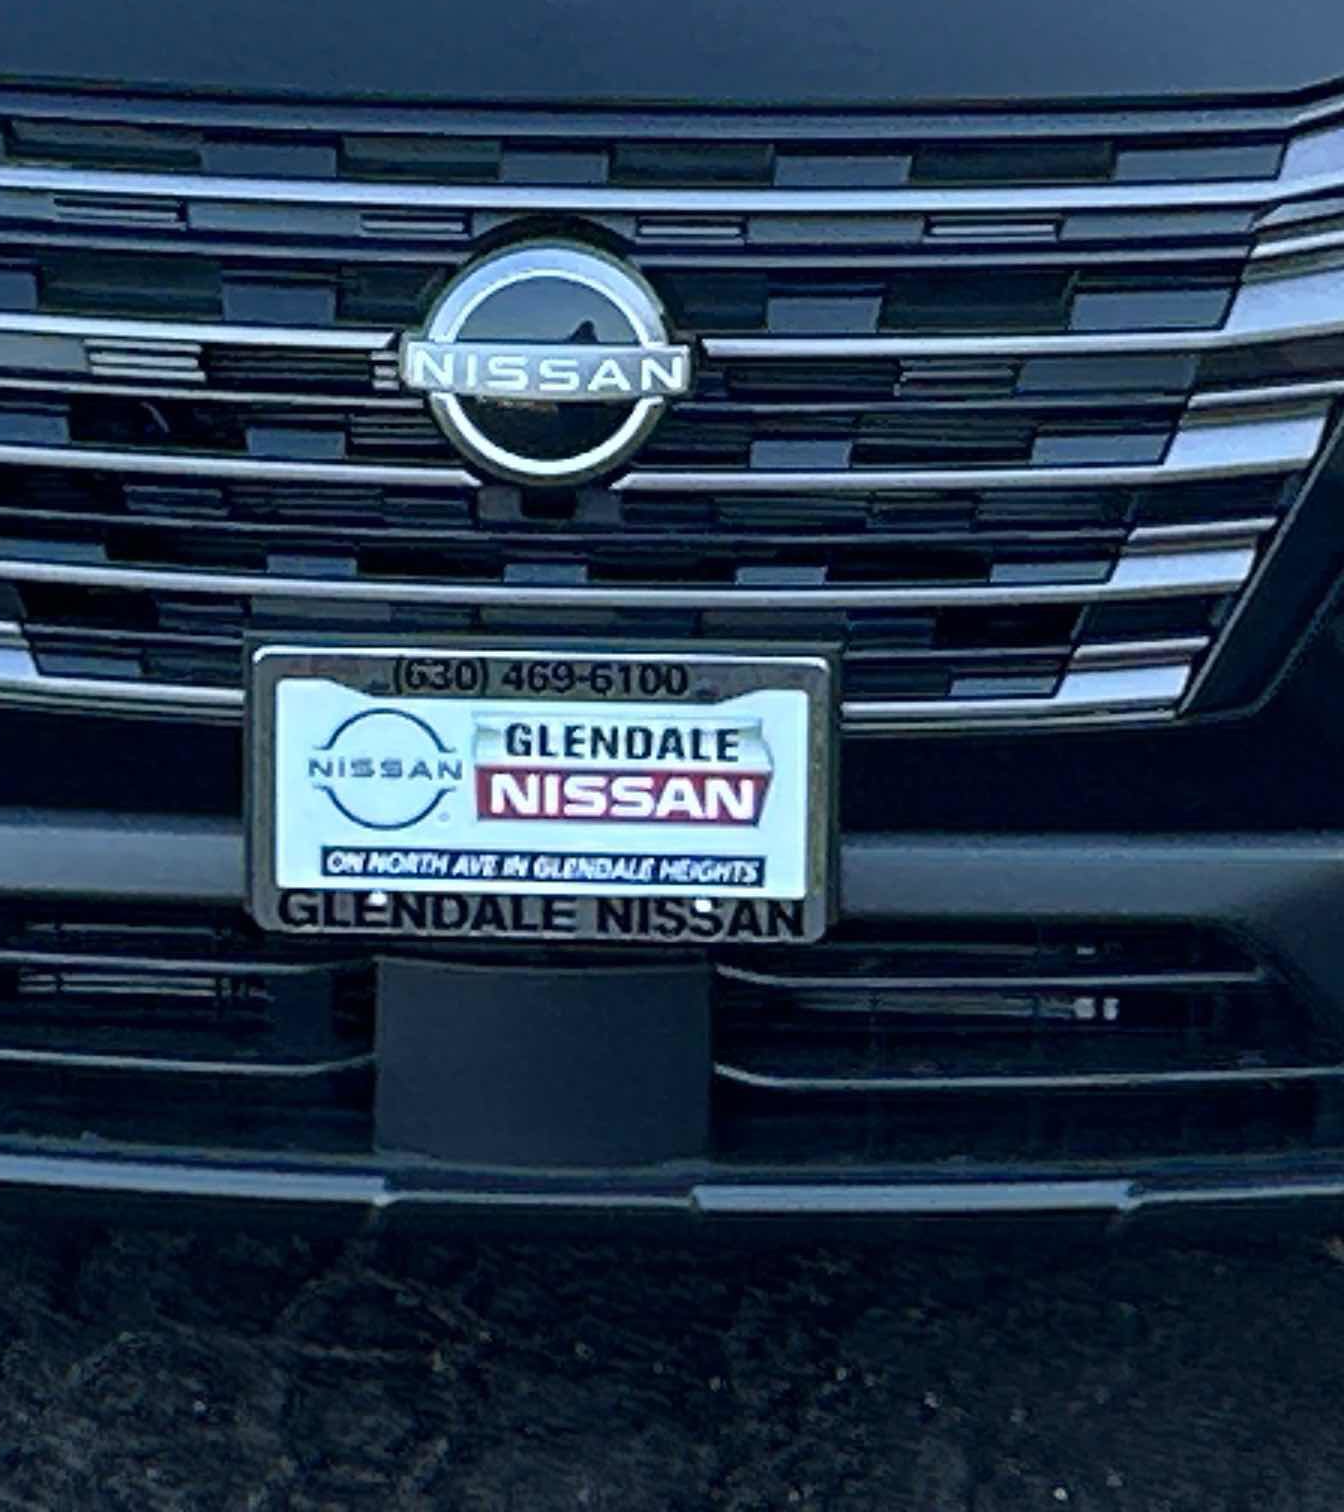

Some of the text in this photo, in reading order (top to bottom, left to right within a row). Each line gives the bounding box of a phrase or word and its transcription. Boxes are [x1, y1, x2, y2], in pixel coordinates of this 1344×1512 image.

[411, 349, 683, 391] NISSAN
[393, 655, 689, 696] (630) 469-6100
[505, 721, 740, 764] GLENDALE
[307, 755, 463, 781] NISSAN
[490, 772, 754, 821] NISSAN
[327, 851, 760, 884] ON NORTH AVE IN GLENDALE HEIGHTS
[276, 890, 805, 938] GLENDALE NISSAN
